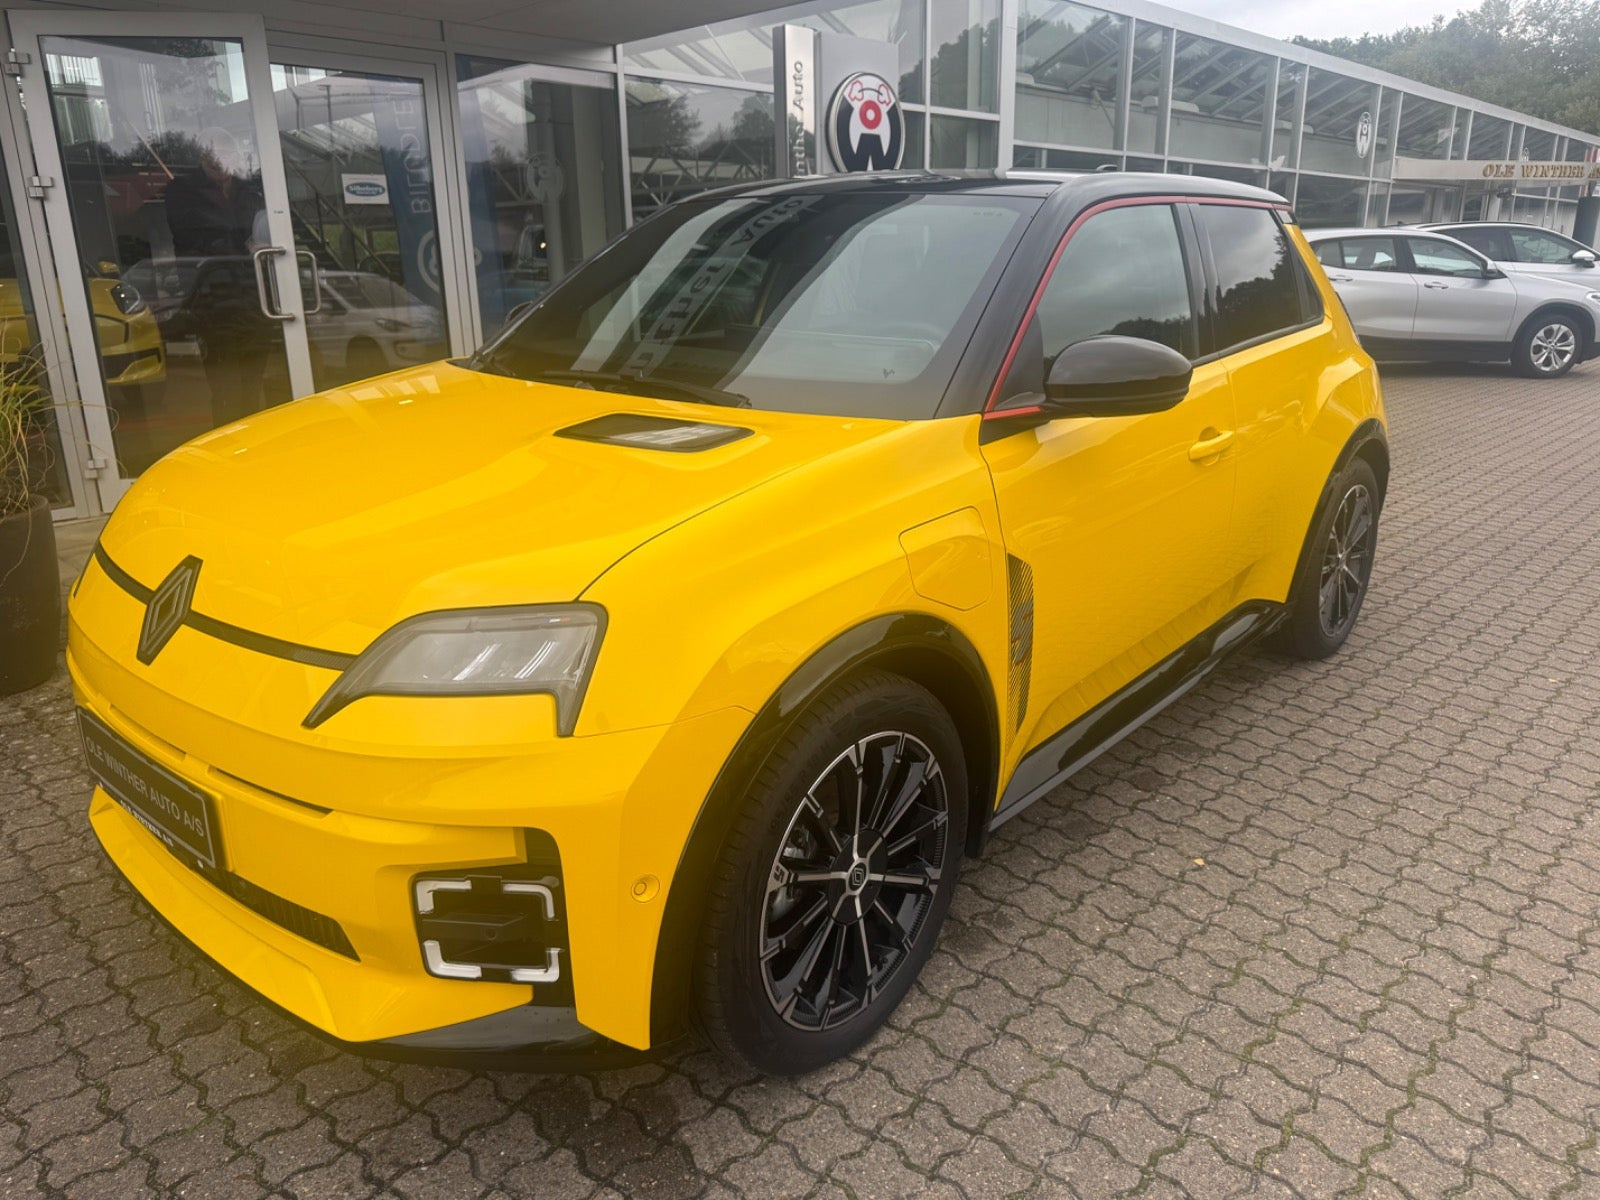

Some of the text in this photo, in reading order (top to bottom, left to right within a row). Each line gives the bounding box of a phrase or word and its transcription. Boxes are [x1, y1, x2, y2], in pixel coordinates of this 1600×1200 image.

[792, 60, 804, 111] Auto
[1482, 163, 1516, 178] OLE
[1521, 164, 1585, 178] WINTHER
[85, 736, 205, 838] OLE WINTHER AUTO A/S
